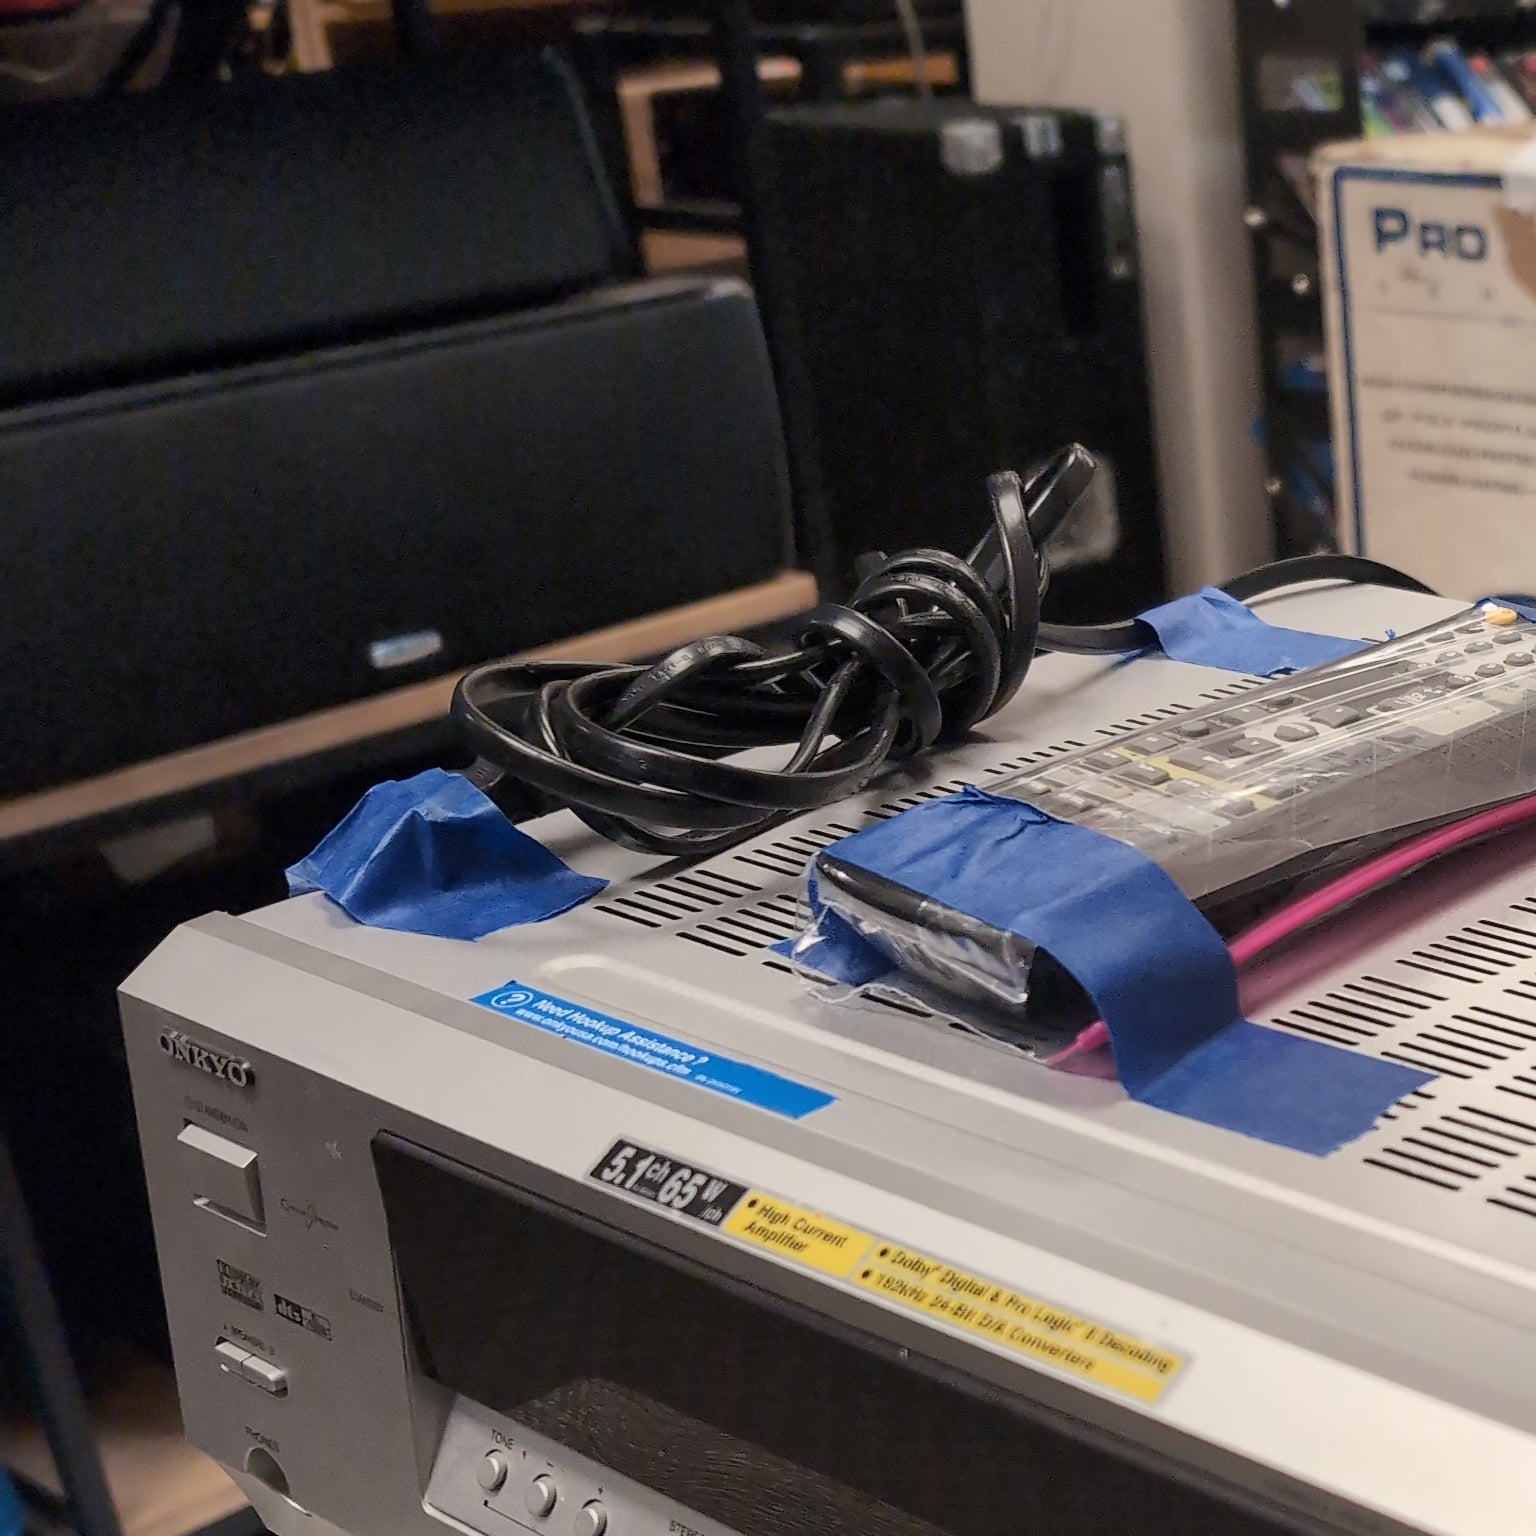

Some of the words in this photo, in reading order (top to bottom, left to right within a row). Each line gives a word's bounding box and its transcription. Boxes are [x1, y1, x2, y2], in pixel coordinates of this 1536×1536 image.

[1373, 207, 1489, 261] PRO
[532, 998, 569, 1019] Need
[567, 1009, 622, 1037] Hookup
[617, 1030, 696, 1063] Assistance
[160, 1034, 248, 1088] ONKYO
[744, 1221, 809, 1253] Amplifier
[758, 1204, 790, 1226] High
[792, 1217, 849, 1248] Current
[939, 1269, 991, 1298] Digital
[1100, 1330, 1173, 1374] Decoding
[1009, 1325, 1094, 1371] Converters
[491, 1428, 515, 1450] TONE
